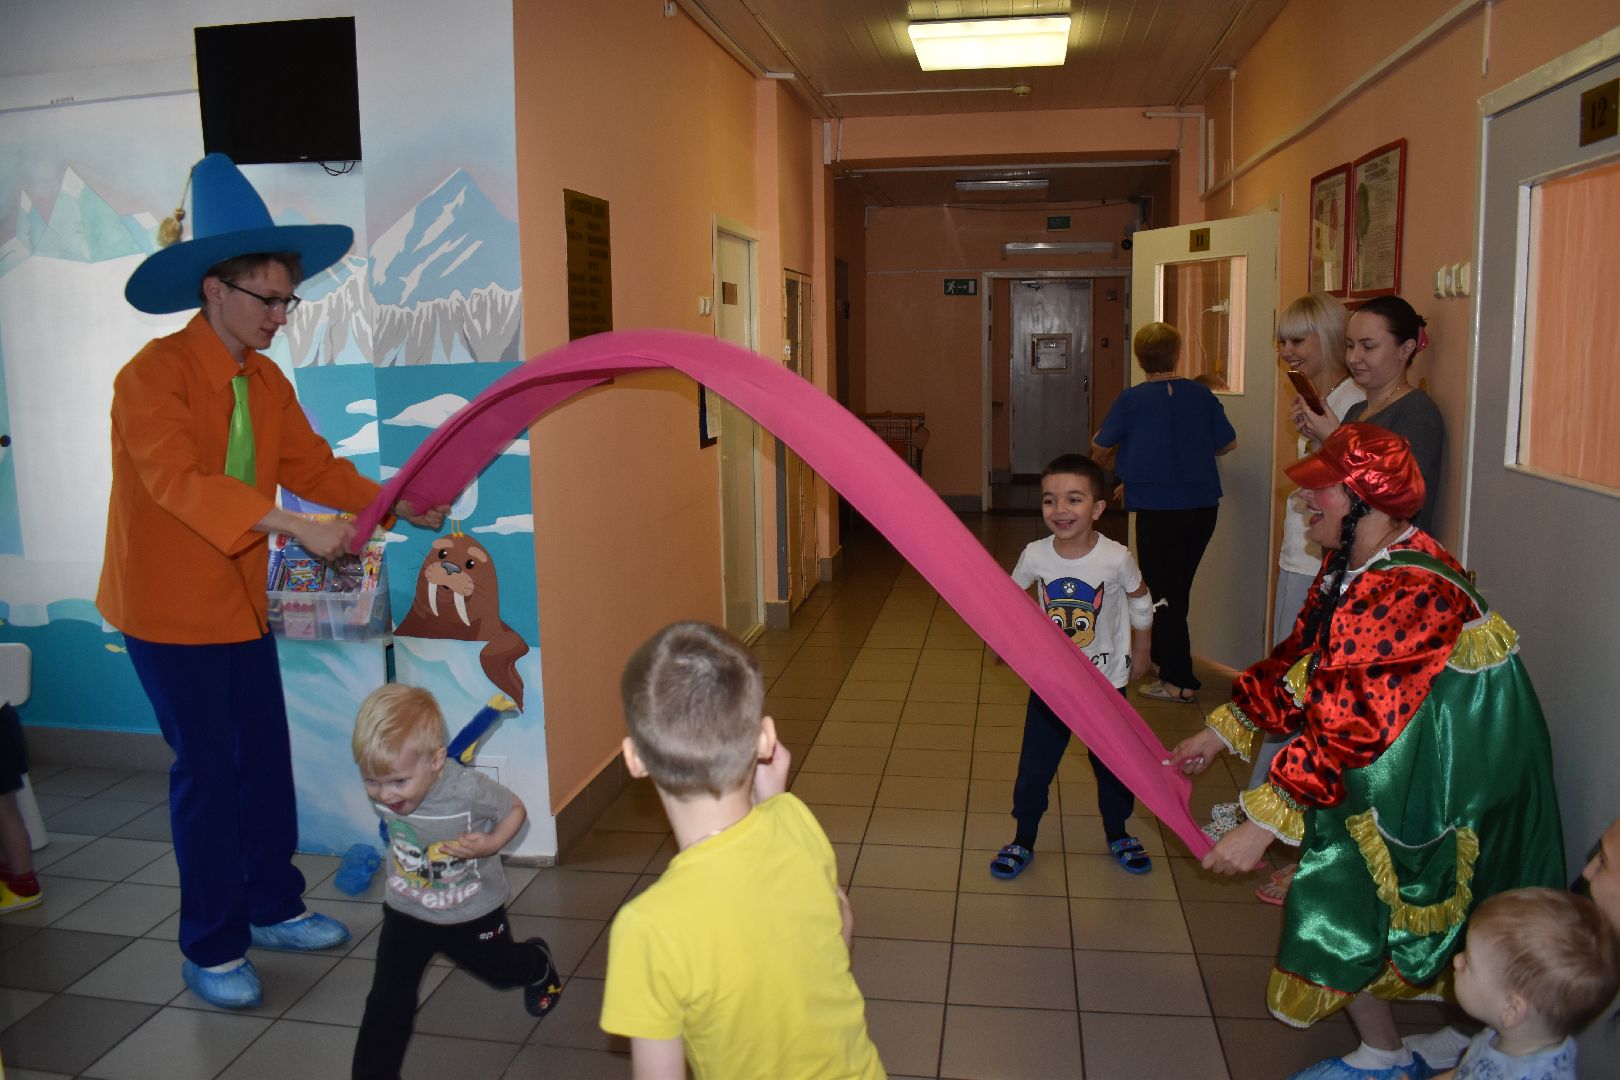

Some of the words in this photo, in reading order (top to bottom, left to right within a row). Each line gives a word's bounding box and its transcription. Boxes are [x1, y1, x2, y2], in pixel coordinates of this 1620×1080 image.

[1590, 97, 1608, 130] 12
[1196, 234, 1204, 247] 11
[1090, 652, 1109, 665] CT
